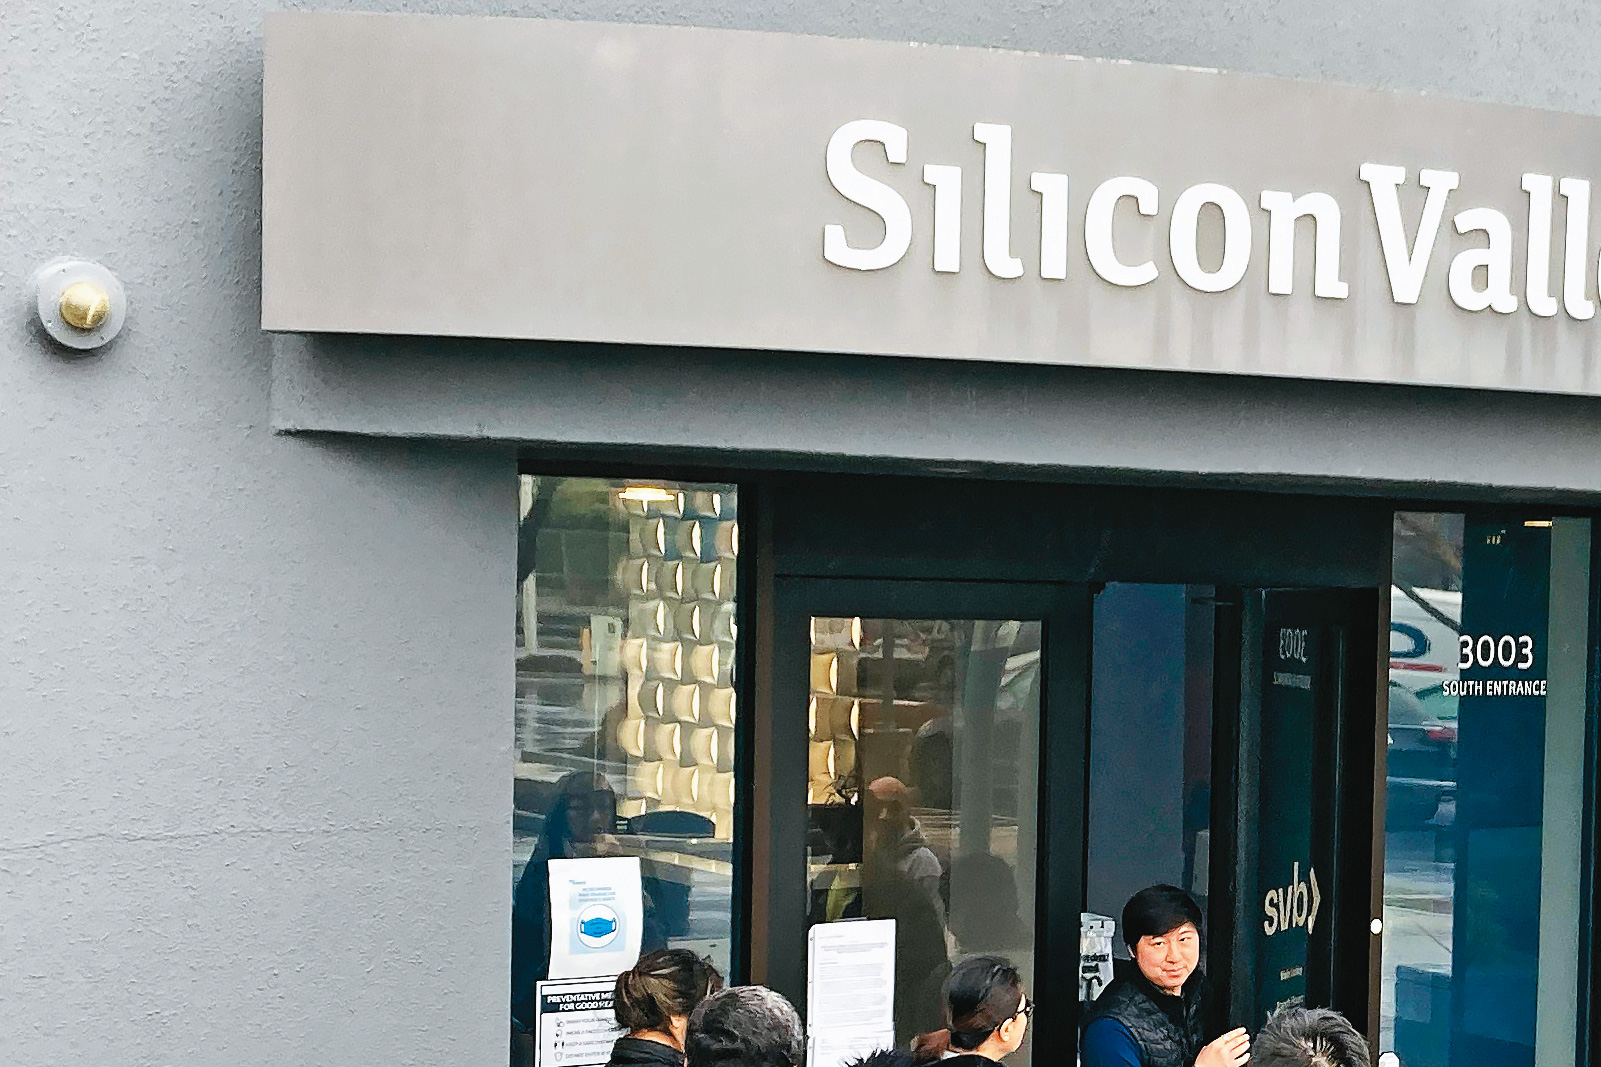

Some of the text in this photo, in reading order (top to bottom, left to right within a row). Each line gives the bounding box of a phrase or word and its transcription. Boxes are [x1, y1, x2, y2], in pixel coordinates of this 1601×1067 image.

[823, 119, 1349, 300] Silicon
[1457, 634, 1533, 670] 3003
[1442, 680, 1547, 697] SOUTH ENTRANCE
[560, 1002, 575, 1011] FOR
[575, 1001, 598, 1010] GOOD
